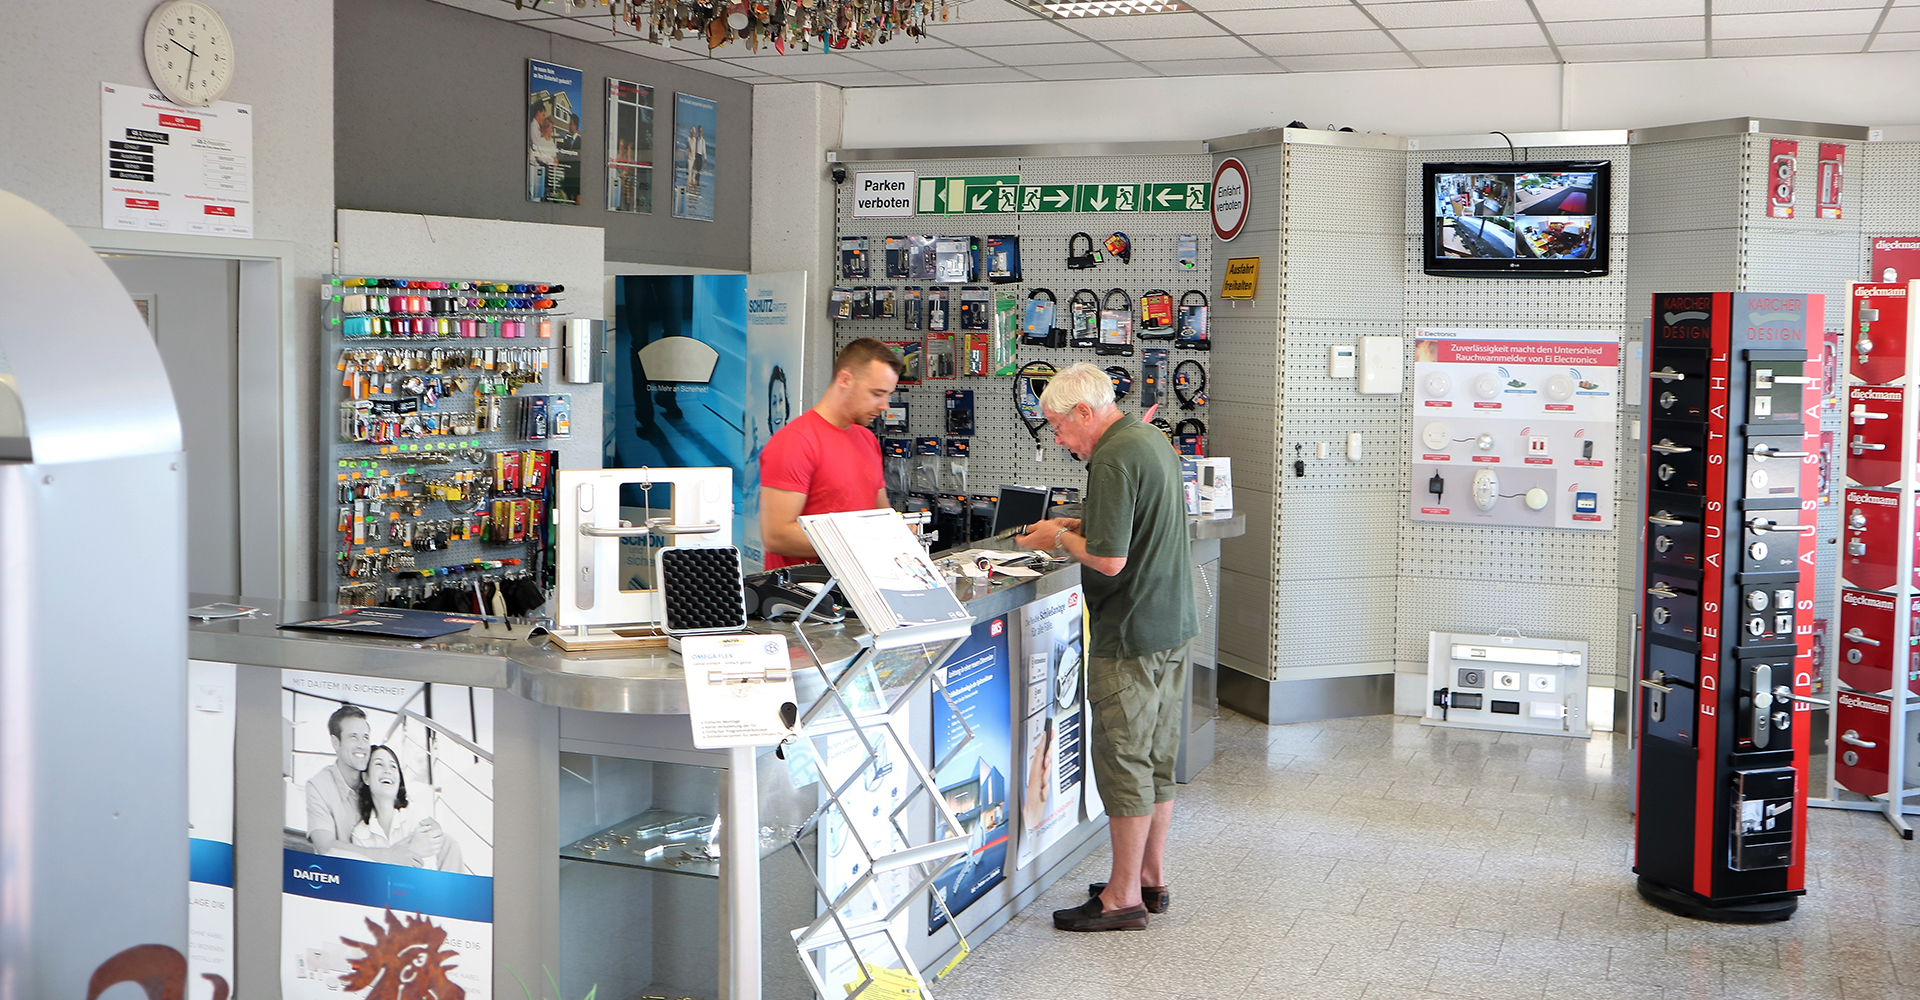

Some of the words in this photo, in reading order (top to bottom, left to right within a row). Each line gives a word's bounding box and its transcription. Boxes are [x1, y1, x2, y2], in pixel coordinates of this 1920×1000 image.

[188, 16, 196, 24] 12
[168, 28, 175, 36] 10
[164, 44, 169, 52] 9
[214, 54, 219, 62] 3
[168, 61, 173, 70] 8
[190, 82, 194, 90] 6
[202, 80, 206, 88] 5
[864, 180, 905, 191] Parken
[1218, 185, 1242, 198] Einfahrt
[858, 196, 910, 208] verboten
[1216, 200, 1242, 212] verboten
[1876, 240, 1920, 251] dieckman
[1229, 264, 1254, 274] Ausfahrt
[1224, 280, 1252, 290] freihalten
[1855, 286, 1906, 298] dieckmann
[1664, 297, 1710, 310] KARCHER
[1748, 298, 1802, 311] KARCHER
[1663, 326, 1710, 339] DESIGN
[1747, 327, 1801, 340] DESIGN
[1451, 344, 1508, 354] Zuverlässigkeit
[1510, 346, 1536, 354] macht
[1537, 346, 1552, 354] den
[1554, 347, 1602, 355] Unterschied
[1456, 354, 1526, 362] Rauchwarnmelder
[1554, 355, 1598, 364] Electronics
[1850, 388, 1902, 401] dieckmann
[1709, 353, 1727, 465] STAHL
[1803, 354, 1822, 465] STAHL
[1847, 492, 1898, 506] dieckmann
[1706, 501, 1722, 568] AUS
[1800, 500, 1817, 565] AUS
[1843, 592, 1894, 610] dieckmann
[991, 621, 1003, 636] BKS
[1702, 602, 1718, 716] EDLES
[1795, 600, 1814, 712] EDLES
[307, 680, 340, 690] DAITEM
[354, 684, 406, 696] SICHERHEIT
[1838, 694, 1889, 713] dieckmann
[293, 868, 340, 885] DAITEM
[188, 898, 210, 908] LAGE
[211, 900, 225, 910] D16
[444, 938, 462, 948] AGE
[464, 940, 481, 951] D16
